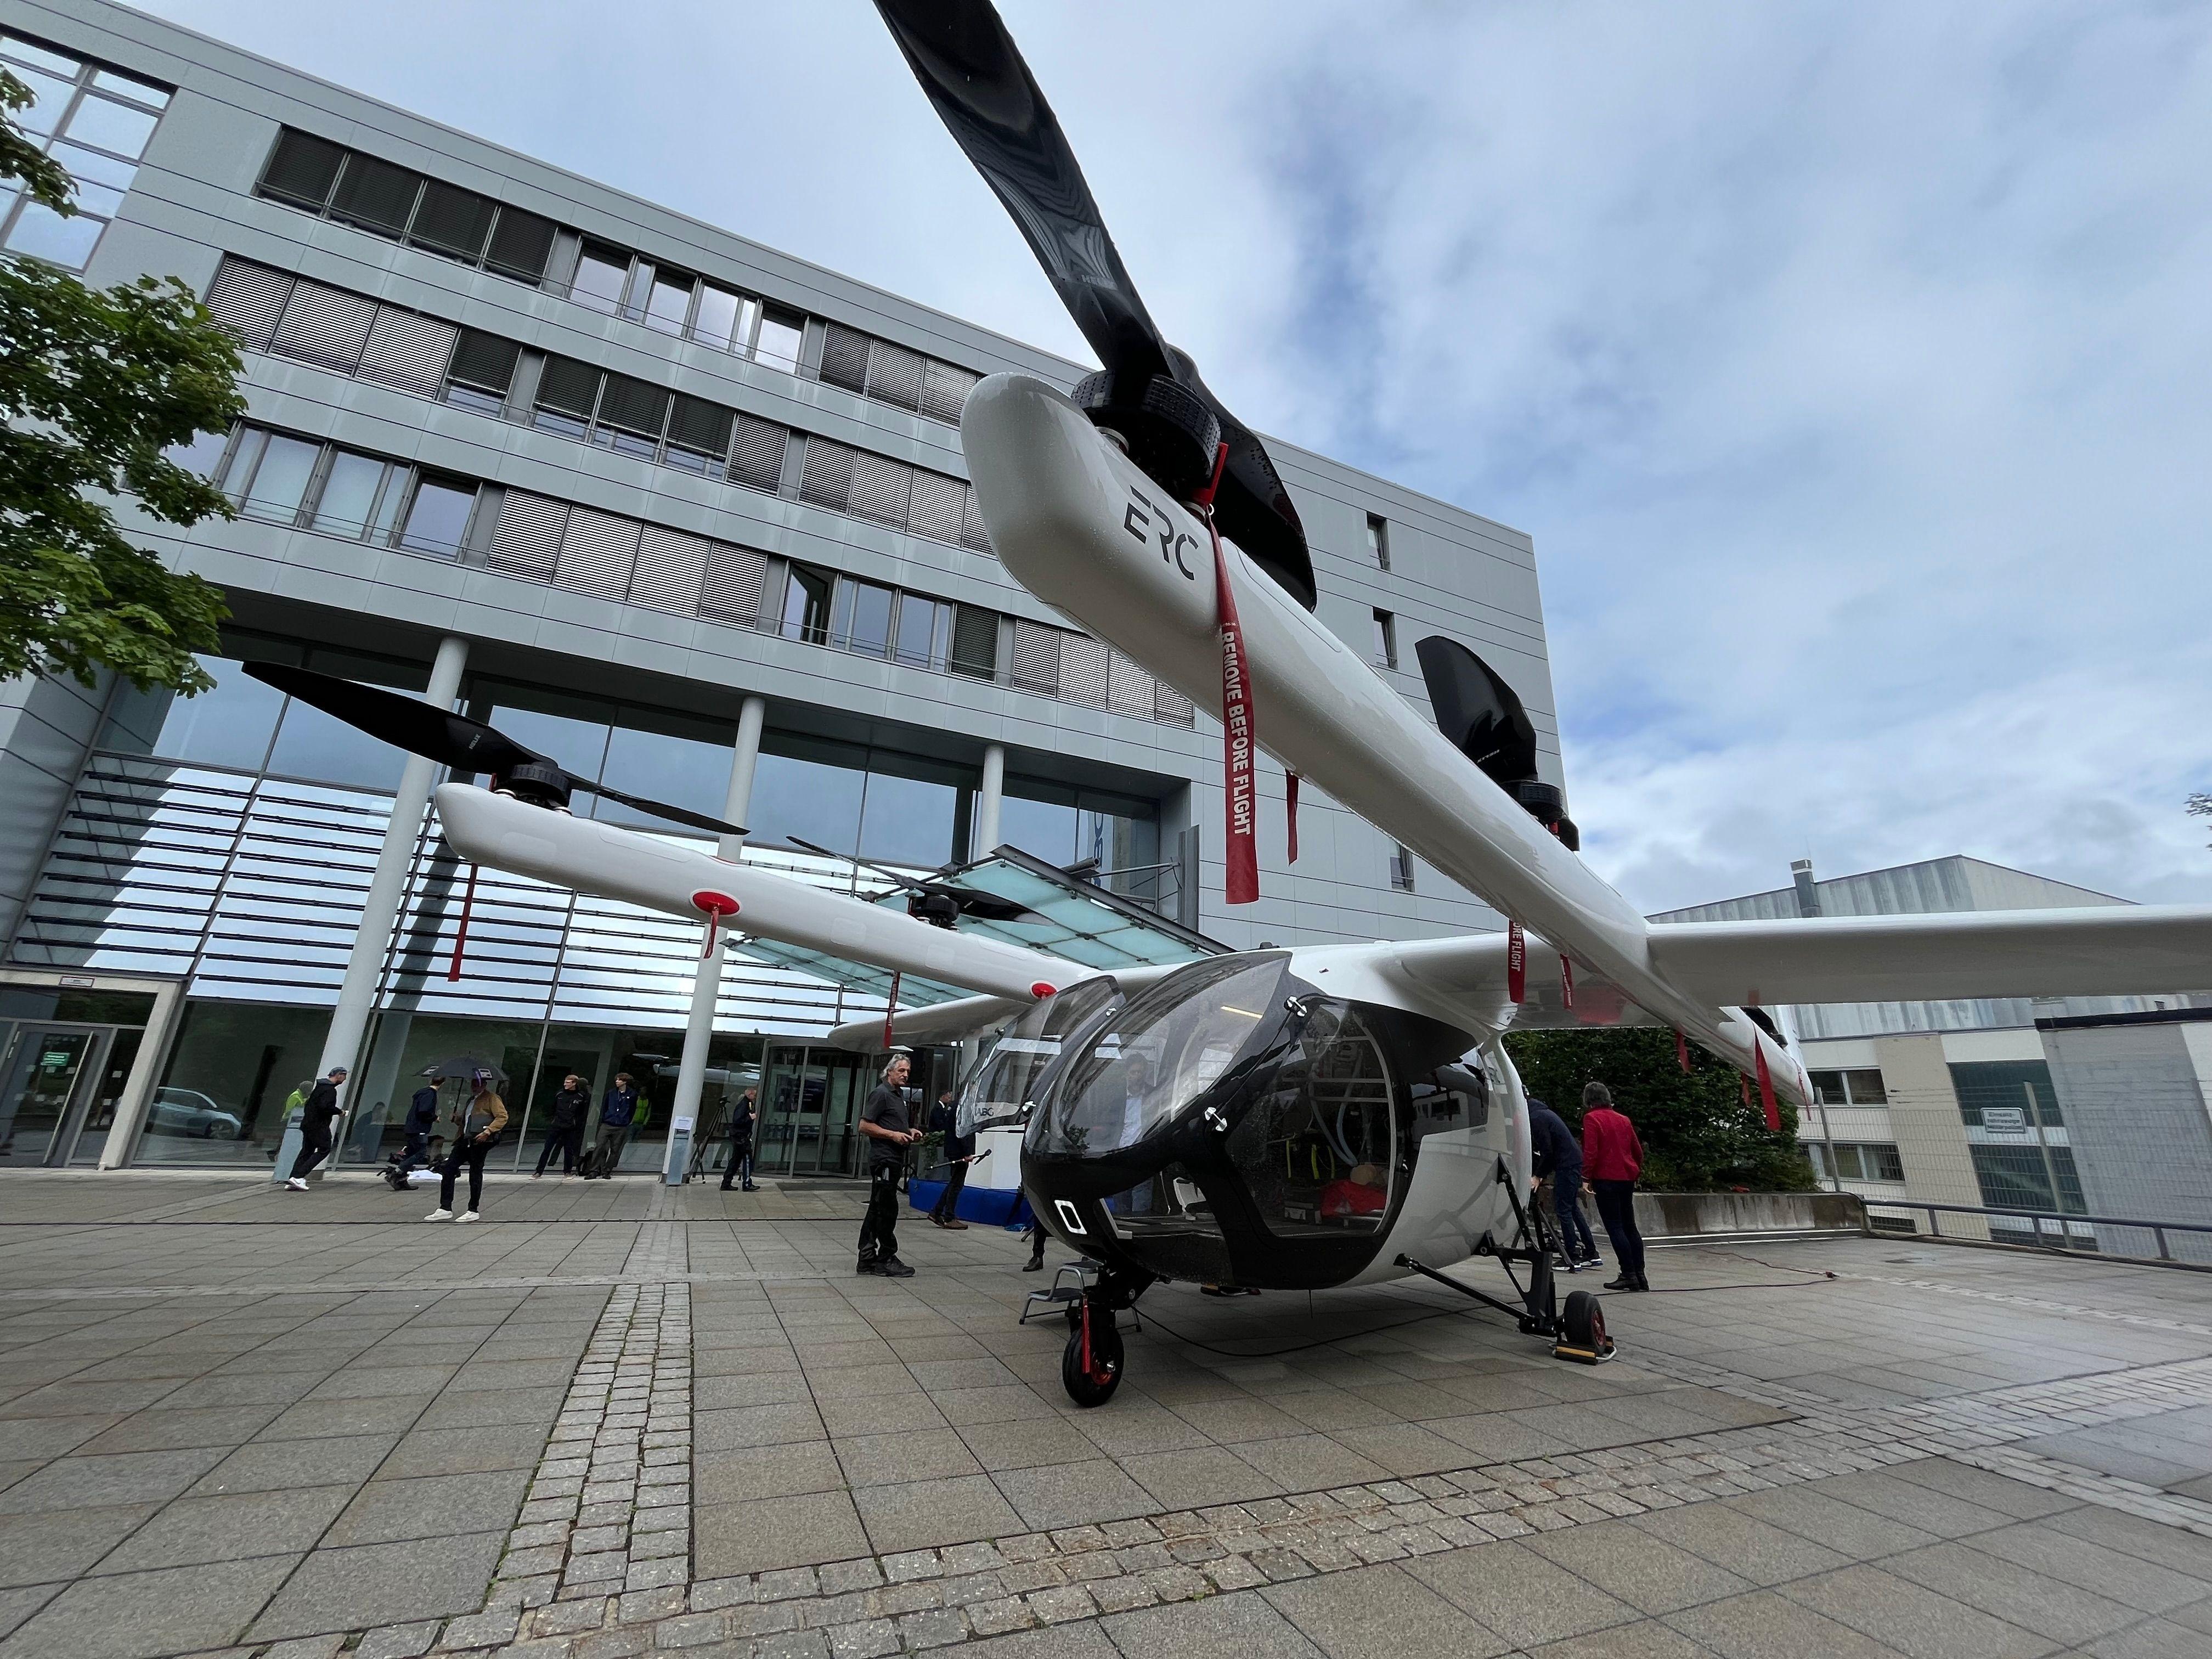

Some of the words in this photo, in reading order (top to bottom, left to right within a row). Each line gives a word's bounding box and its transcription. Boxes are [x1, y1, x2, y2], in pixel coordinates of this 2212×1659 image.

[1124, 485, 1199, 580] ERC
[1223, 631, 1243, 703] REMOVE
[1228, 704, 1249, 772] BEFORE
[1233, 774, 1251, 835] FLIGHT
[1511, 940, 1522, 972] FLIGHT
[1512, 922, 1522, 939] ORE
